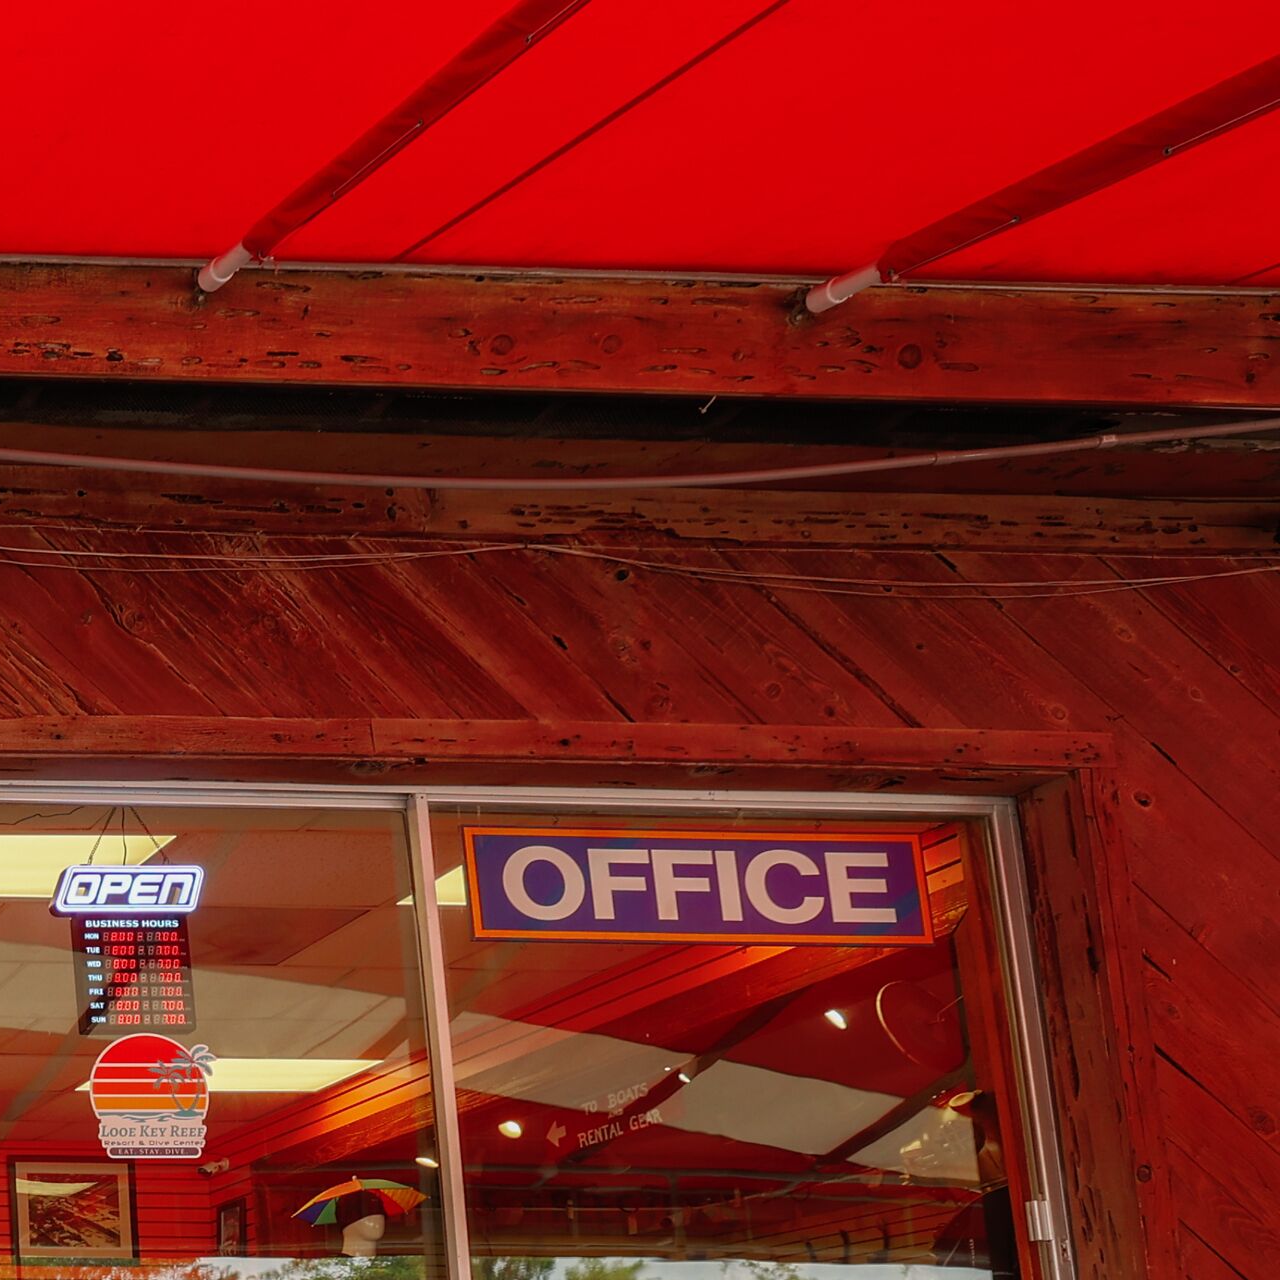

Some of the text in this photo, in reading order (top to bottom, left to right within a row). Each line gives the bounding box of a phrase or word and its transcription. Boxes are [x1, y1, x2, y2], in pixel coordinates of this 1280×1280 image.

[502, 844, 897, 925] OFFICE
[66, 873, 194, 905] OPEN
[85, 919, 179, 928] BUSINESS HOURS
[84, 932, 99, 940] MON
[86, 946, 100, 954] TUE
[87, 960, 102, 968] WED
[88, 974, 102, 982] THU
[89, 988, 104, 996] FRI
[90, 1002, 104, 1010] SAT
[91, 1016, 106, 1024] SUN
[581, 1082, 649, 1116] TO BOATS
[577, 1108, 663, 1148] RENTAL GEAR
